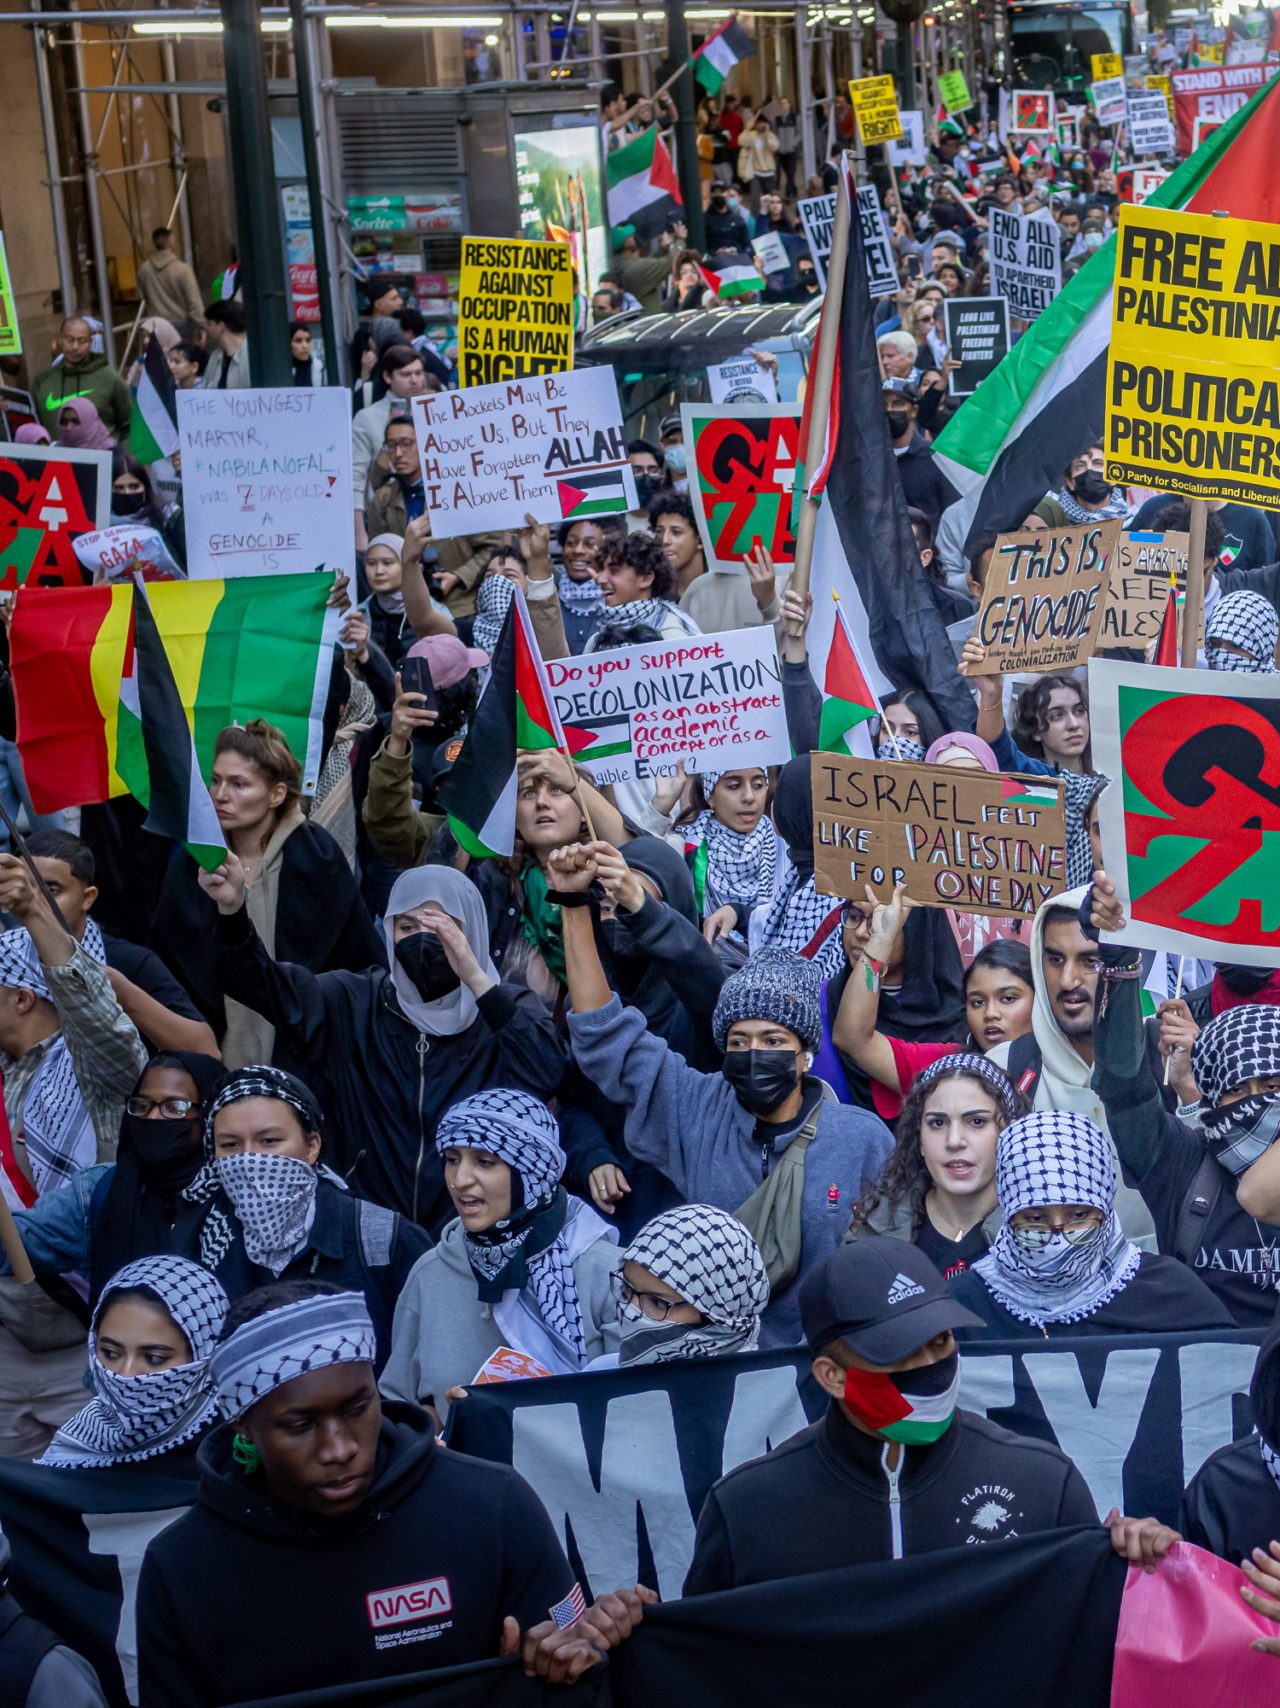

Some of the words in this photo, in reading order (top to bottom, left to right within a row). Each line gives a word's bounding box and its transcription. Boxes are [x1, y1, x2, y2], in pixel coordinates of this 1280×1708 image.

[1172, 73, 1222, 91] STAND
[1223, 68, 1262, 86] WITH
[993, 212, 1020, 241] END
[1026, 220, 1055, 247] ALL
[465, 244, 568, 271] RESISTANCE
[994, 236, 1022, 265] U.S.
[1027, 245, 1054, 270] AID
[1120, 225, 1225, 292] FREE
[478, 271, 553, 297] AGAINST
[994, 264, 1005, 279] TO
[1006, 268, 1056, 289] APARTHEID
[462, 297, 570, 325] OCCUPATION
[960, 312, 979, 323] LONG
[979, 311, 994, 322] LIVE
[464, 327, 479, 349] IS
[483, 328, 494, 350] A
[498, 329, 568, 355] HUMAN
[956, 324, 1000, 335] PALESTINIAN
[962, 337, 994, 348] FREEDOM
[961, 349, 993, 361] FIGHTERS
[184, 398, 216, 414] THE
[224, 394, 316, 417] YOUNGEST
[417, 398, 448, 425] The
[451, 395, 505, 420] Rockets
[507, 385, 541, 405] May
[544, 379, 568, 401] Be
[188, 428, 269, 449] MARTYR,
[424, 433, 476, 453] Above
[481, 423, 509, 444] Us,
[512, 414, 547, 438] But
[546, 406, 589, 435] They
[425, 459, 465, 480] Have
[471, 451, 541, 480] Forgotten
[544, 426, 629, 469] ALLAH
[237, 485, 253, 505] 7
[428, 485, 449, 511] Is
[454, 481, 507, 509] Above
[1127, 470, 1153, 485] Party
[1154, 474, 1169, 486] for
[1171, 477, 1218, 495] Socialism
[1221, 485, 1240, 497] and
[262, 512, 274, 526] A
[99, 538, 144, 569] GAZA
[209, 533, 300, 550] GENOCIDE
[263, 554, 279, 569] IS
[979, 584, 1101, 649] GENOCIDE
[546, 662, 583, 687] Do
[588, 658, 630, 688] you
[641, 642, 724, 670] support
[1000, 649, 1078, 671] COLONIALIZATION
[554, 655, 782, 722] DECOLONIZATION
[633, 709, 658, 723] as
[662, 707, 691, 721] an
[695, 695, 781, 714] abstract
[633, 715, 739, 742] academic
[637, 739, 705, 759] concept
[709, 736, 725, 750] or
[731, 733, 751, 744] as
[754, 729, 772, 740] a
[821, 766, 976, 825] ISRAEL
[982, 805, 1042, 828] FELT
[819, 821, 872, 853] LIKE
[905, 823, 1065, 880] PALESTINE
[850, 861, 907, 887] FOR
[935, 869, 1001, 905] ONE
[1010, 878, 1054, 913] DAY
[887, 1284, 926, 1305] adidas
[960, 1484, 1016, 1506] FLATIRON
[373, 1587, 446, 1619] NASA
[375, 1632, 401, 1642] National
[402, 1624, 439, 1637] Aeronautics
[440, 1620, 452, 1629] and
[375, 1640, 397, 1650] Space
[398, 1631, 442, 1645] Administration
